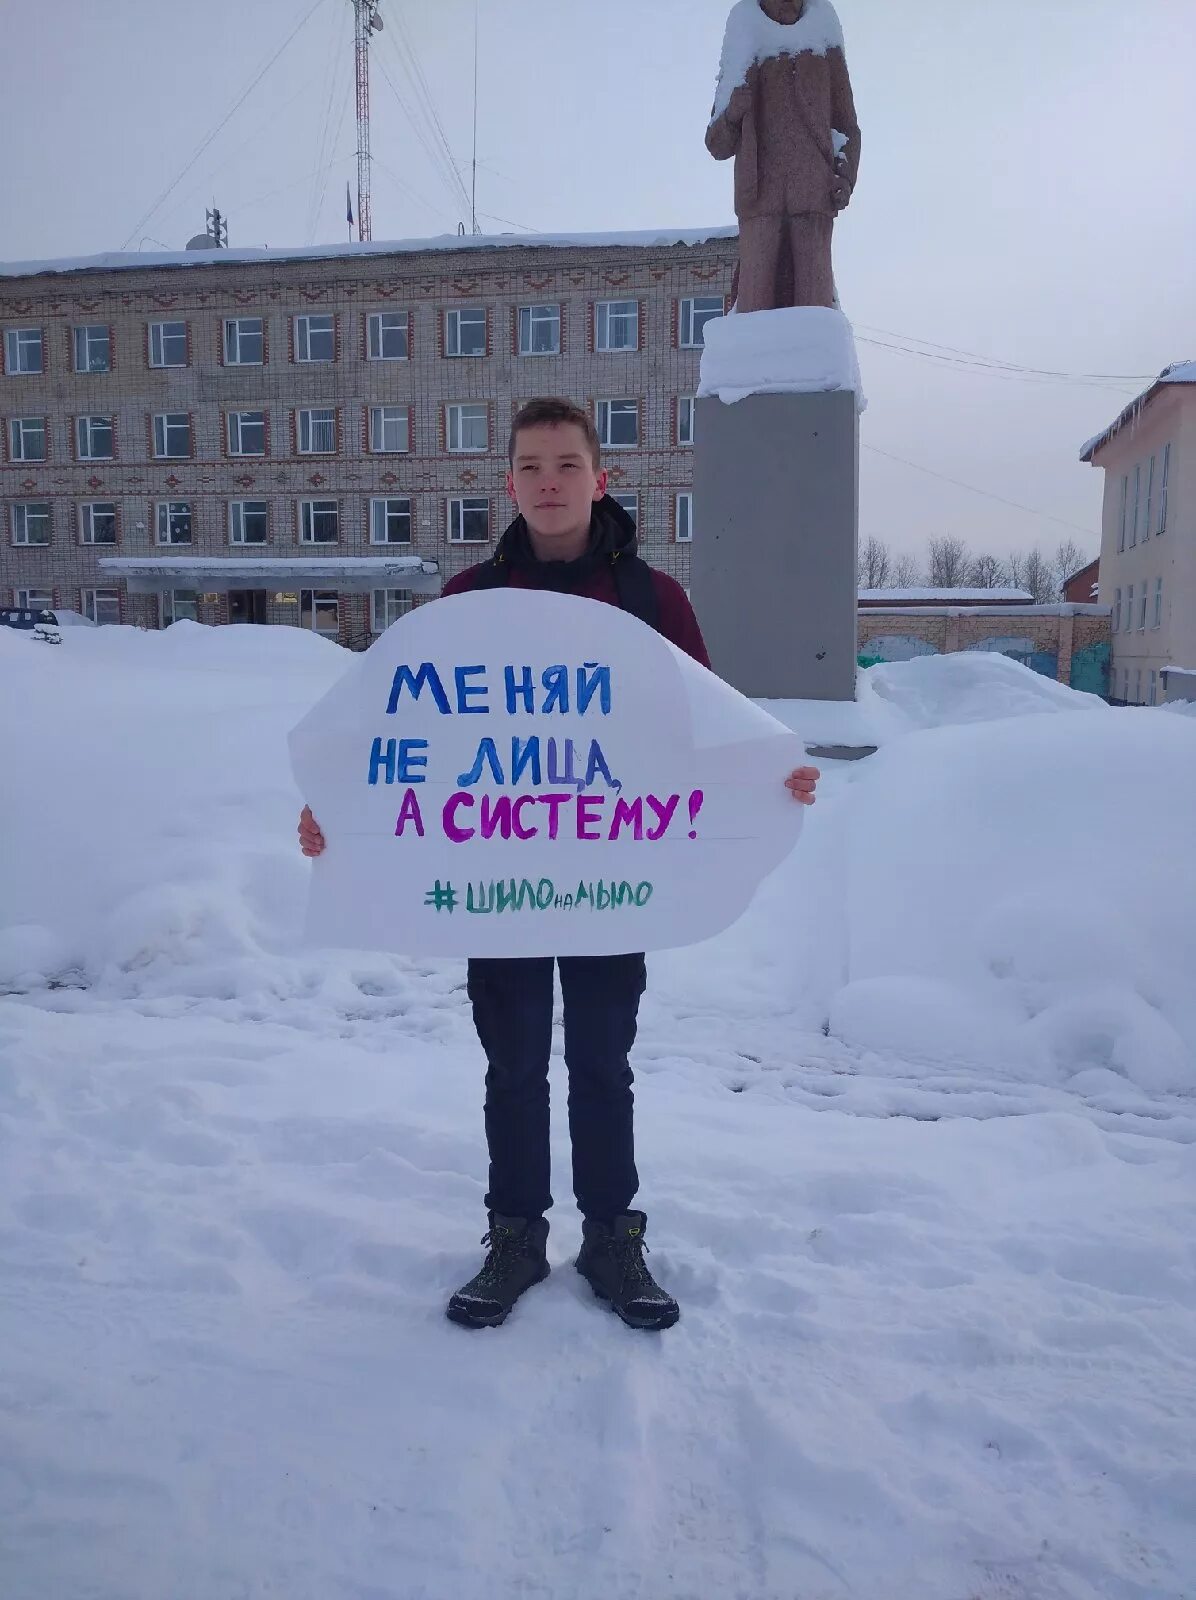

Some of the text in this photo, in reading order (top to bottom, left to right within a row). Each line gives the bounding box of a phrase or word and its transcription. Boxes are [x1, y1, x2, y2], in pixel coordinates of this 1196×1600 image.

[386, 662, 611, 716] МЕНЯЙ
[368, 736, 622, 796] НЕ ЛИЦА,
[395, 787, 704, 843] А СИСТЕМУ!
